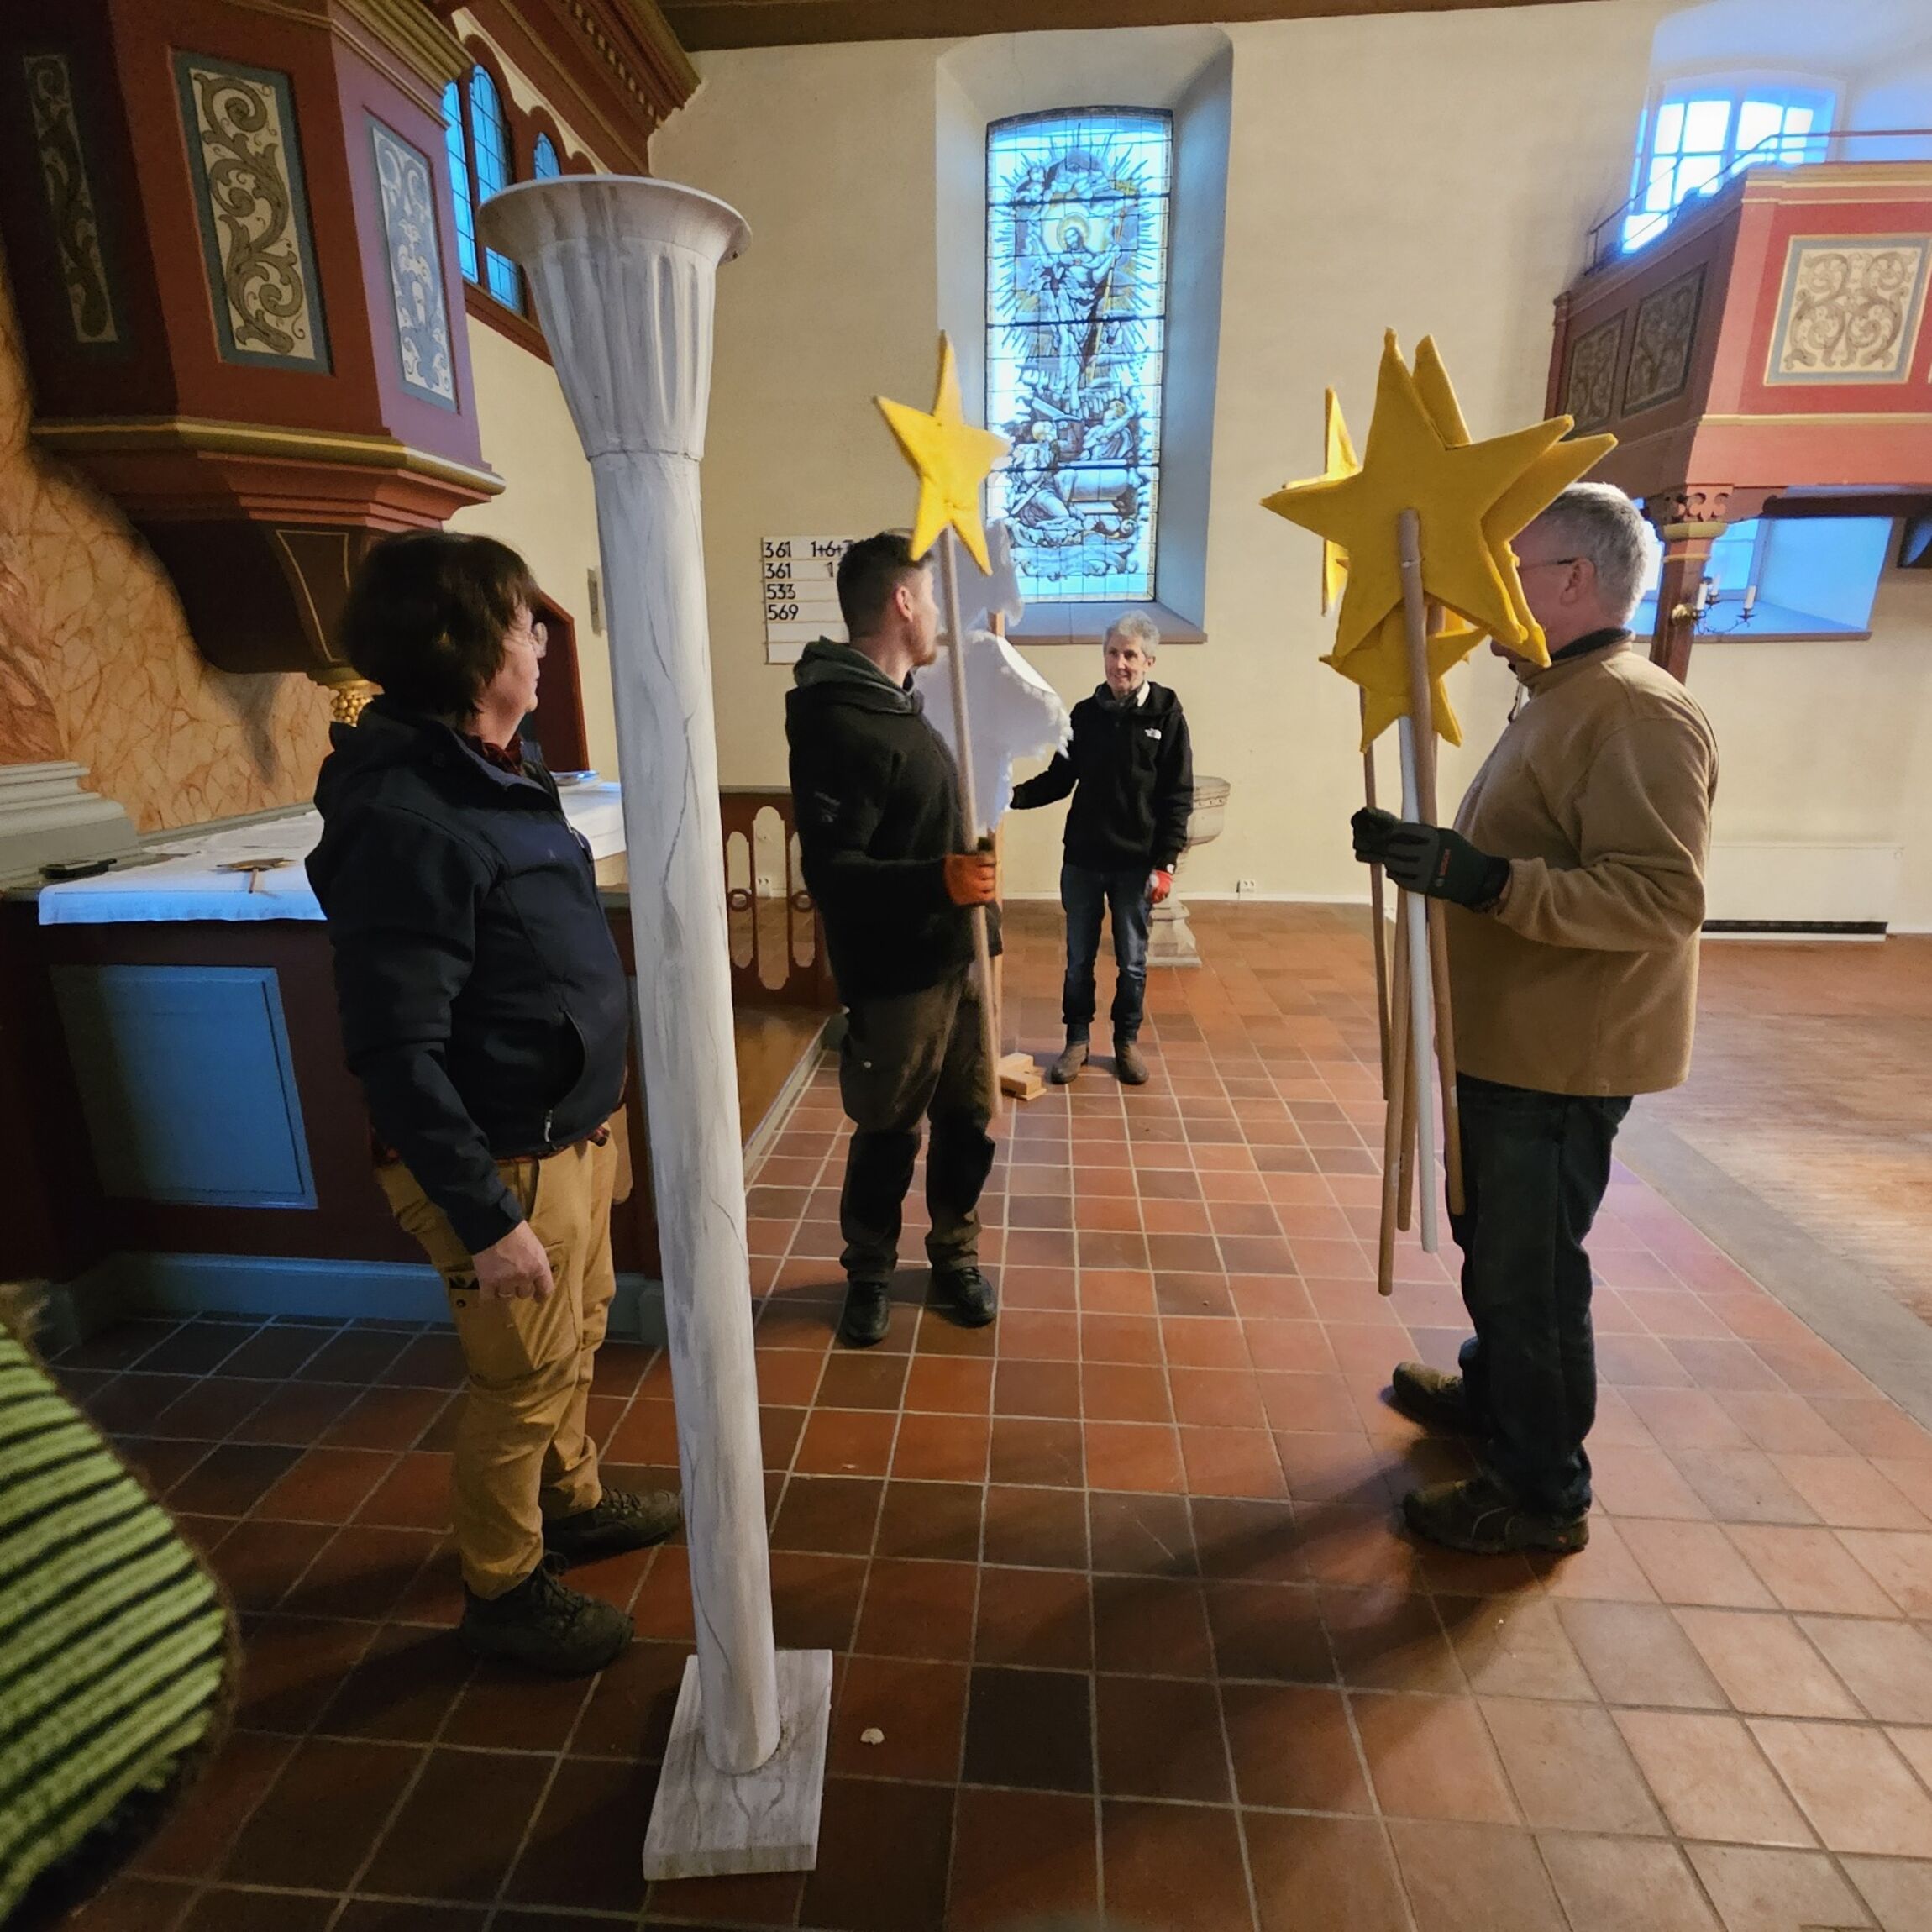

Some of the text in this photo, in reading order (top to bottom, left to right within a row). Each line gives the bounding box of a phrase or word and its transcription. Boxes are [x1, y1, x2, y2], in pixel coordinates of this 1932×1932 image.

[764, 541, 791, 558] 361
[765, 562, 791, 579] 361
[767, 583, 796, 600] 533
[768, 603, 799, 620] 569
